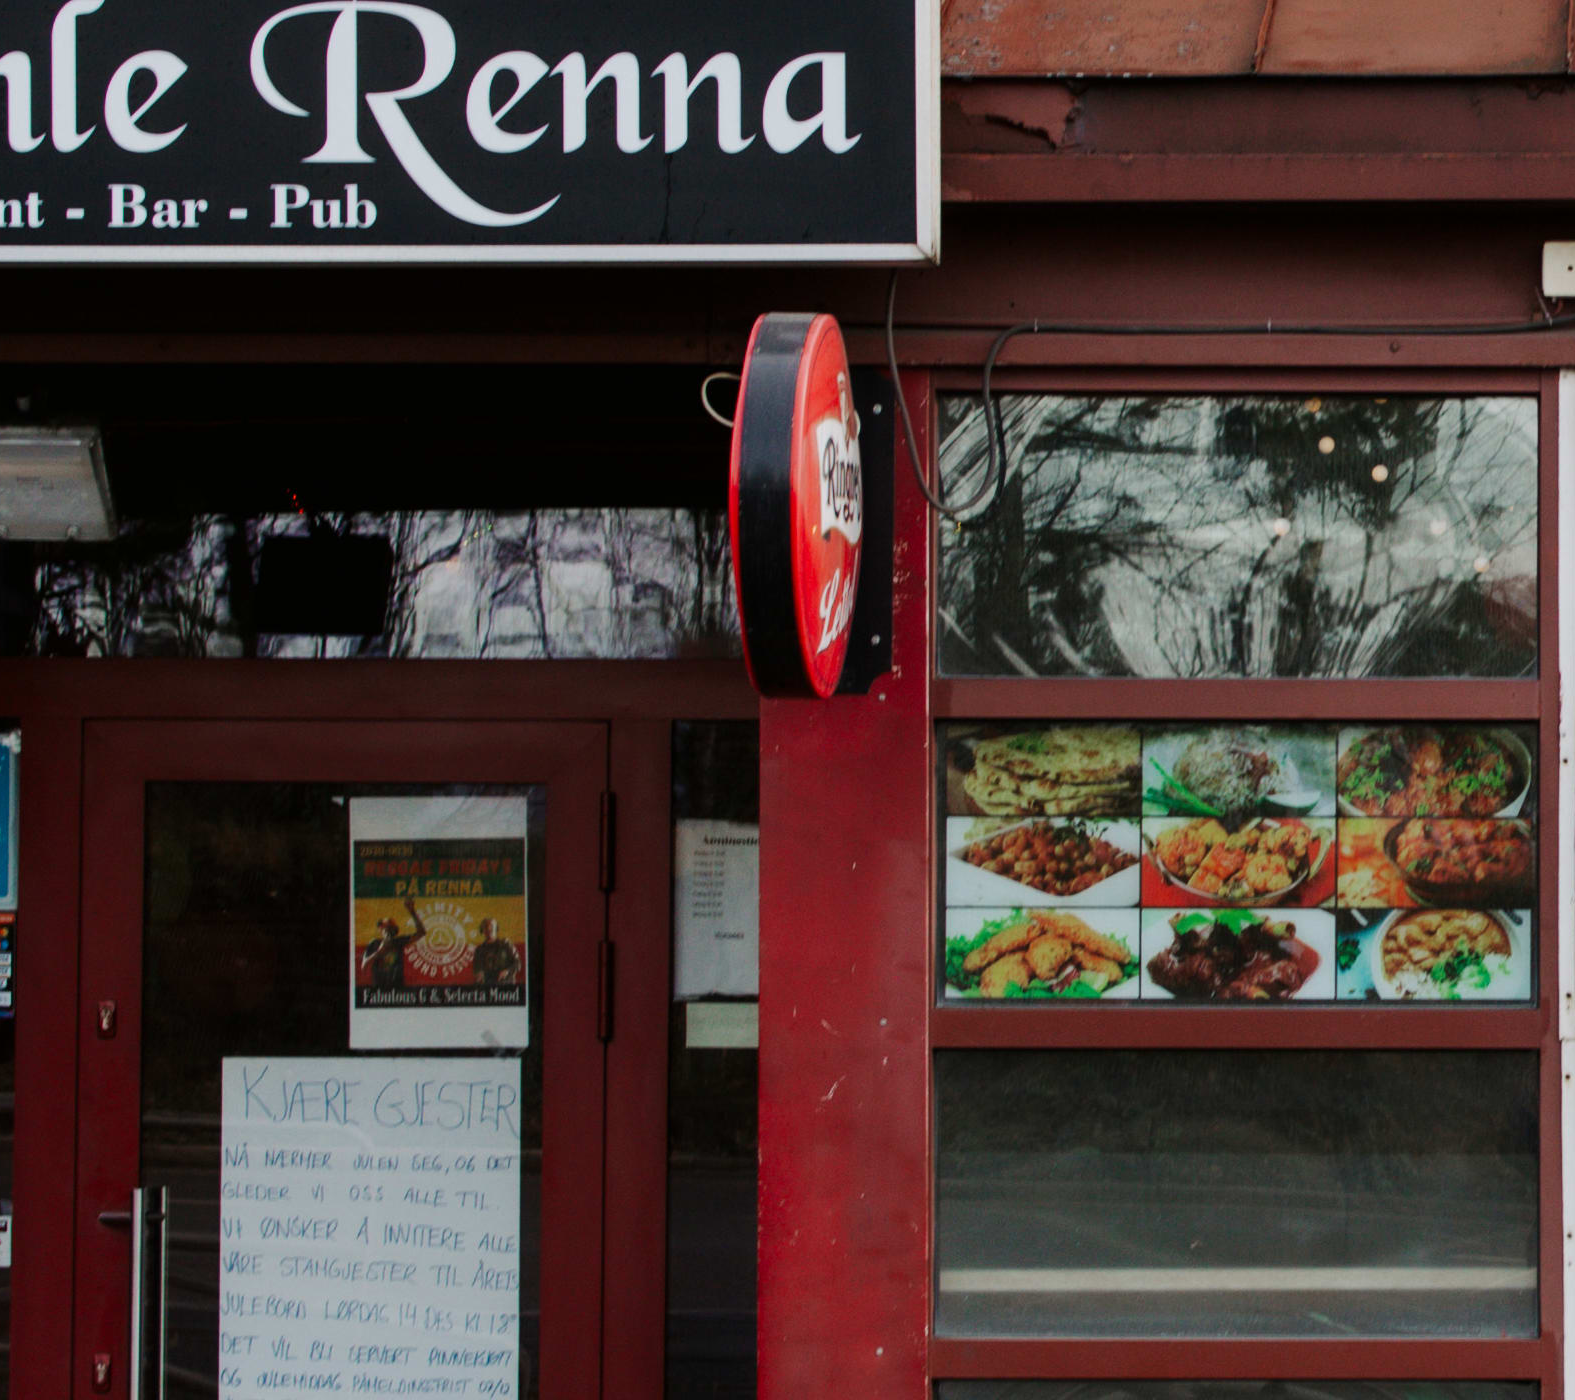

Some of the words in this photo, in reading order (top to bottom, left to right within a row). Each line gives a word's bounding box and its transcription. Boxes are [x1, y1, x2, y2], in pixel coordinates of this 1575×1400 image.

[66, 208, 84, 219] -
[108, 184, 209, 228] Bar
[229, 208, 247, 219] -
[271, 184, 377, 228] Pub
[364, 859, 434, 877] REGGAE
[437, 857, 513, 876] FRIDAYS
[394, 876, 420, 897] PÅ
[425, 878, 484, 897] RENNA
[362, 987, 416, 1005] Fabulous
[444, 987, 486, 1004] Selecta
[489, 986, 521, 1003] Mood
[242, 1065, 362, 1126] KJÆRE
[373, 1079, 520, 1140] GJESTER
[224, 1142, 250, 1169] NÅ
[352, 1155, 399, 1171] JULEN
[221, 1181, 290, 1202] GLEDER
[403, 1186, 448, 1208] ALLE
[260, 1214, 339, 1242] ØNSKER
[355, 1214, 370, 1245] Å
[477, 1231, 519, 1254] ALLE
[429, 1262, 463, 1288] TIL
[221, 1332, 259, 1356] DET
